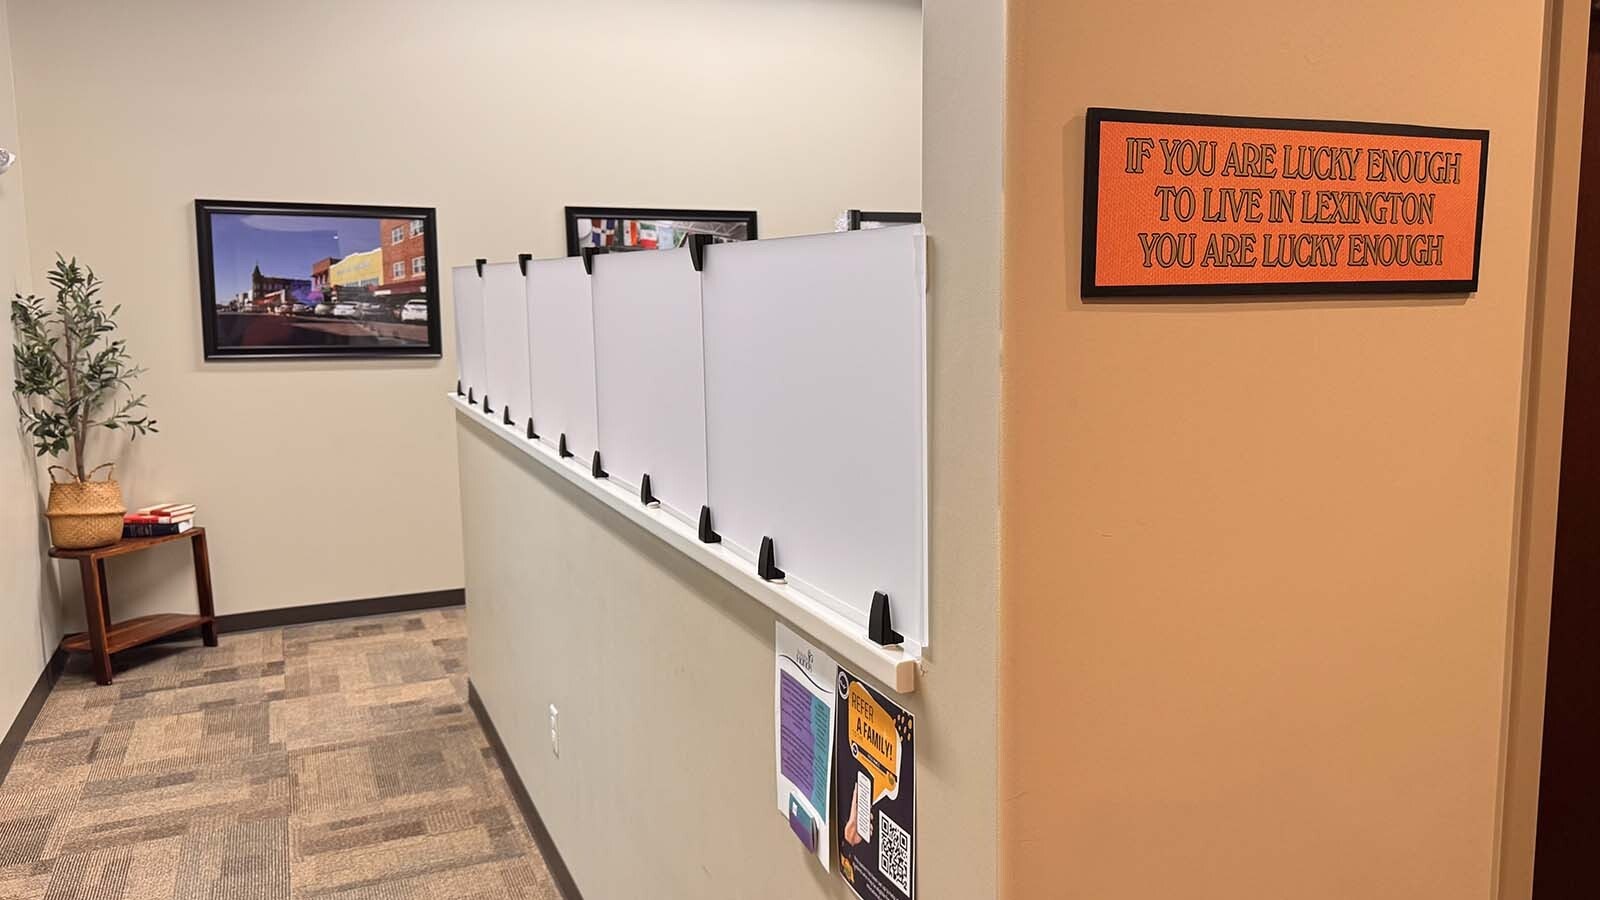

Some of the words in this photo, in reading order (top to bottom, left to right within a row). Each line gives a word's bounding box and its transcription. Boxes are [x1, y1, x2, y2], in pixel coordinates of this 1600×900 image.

[1125, 137, 1153, 173] IF
[1160, 139, 1217, 176] YOU
[1222, 142, 1277, 178] ARE
[1282, 145, 1363, 181] LUCKY
[1367, 149, 1462, 184] ENOUGH
[1155, 185, 1196, 222] TO
[1203, 187, 1263, 223] LIVE
[1269, 189, 1295, 223] IN
[1301, 190, 1435, 225] LEXINGTON
[1138, 232, 1197, 268] YOU
[1201, 233, 1257, 267] ARE
[1262, 233, 1345, 267] LUCKY
[1348, 234, 1444, 266] ENOUGH
[851, 693, 874, 724] REFER
[857, 718, 863, 735] A
[863, 722, 893, 761] FAMILY!
